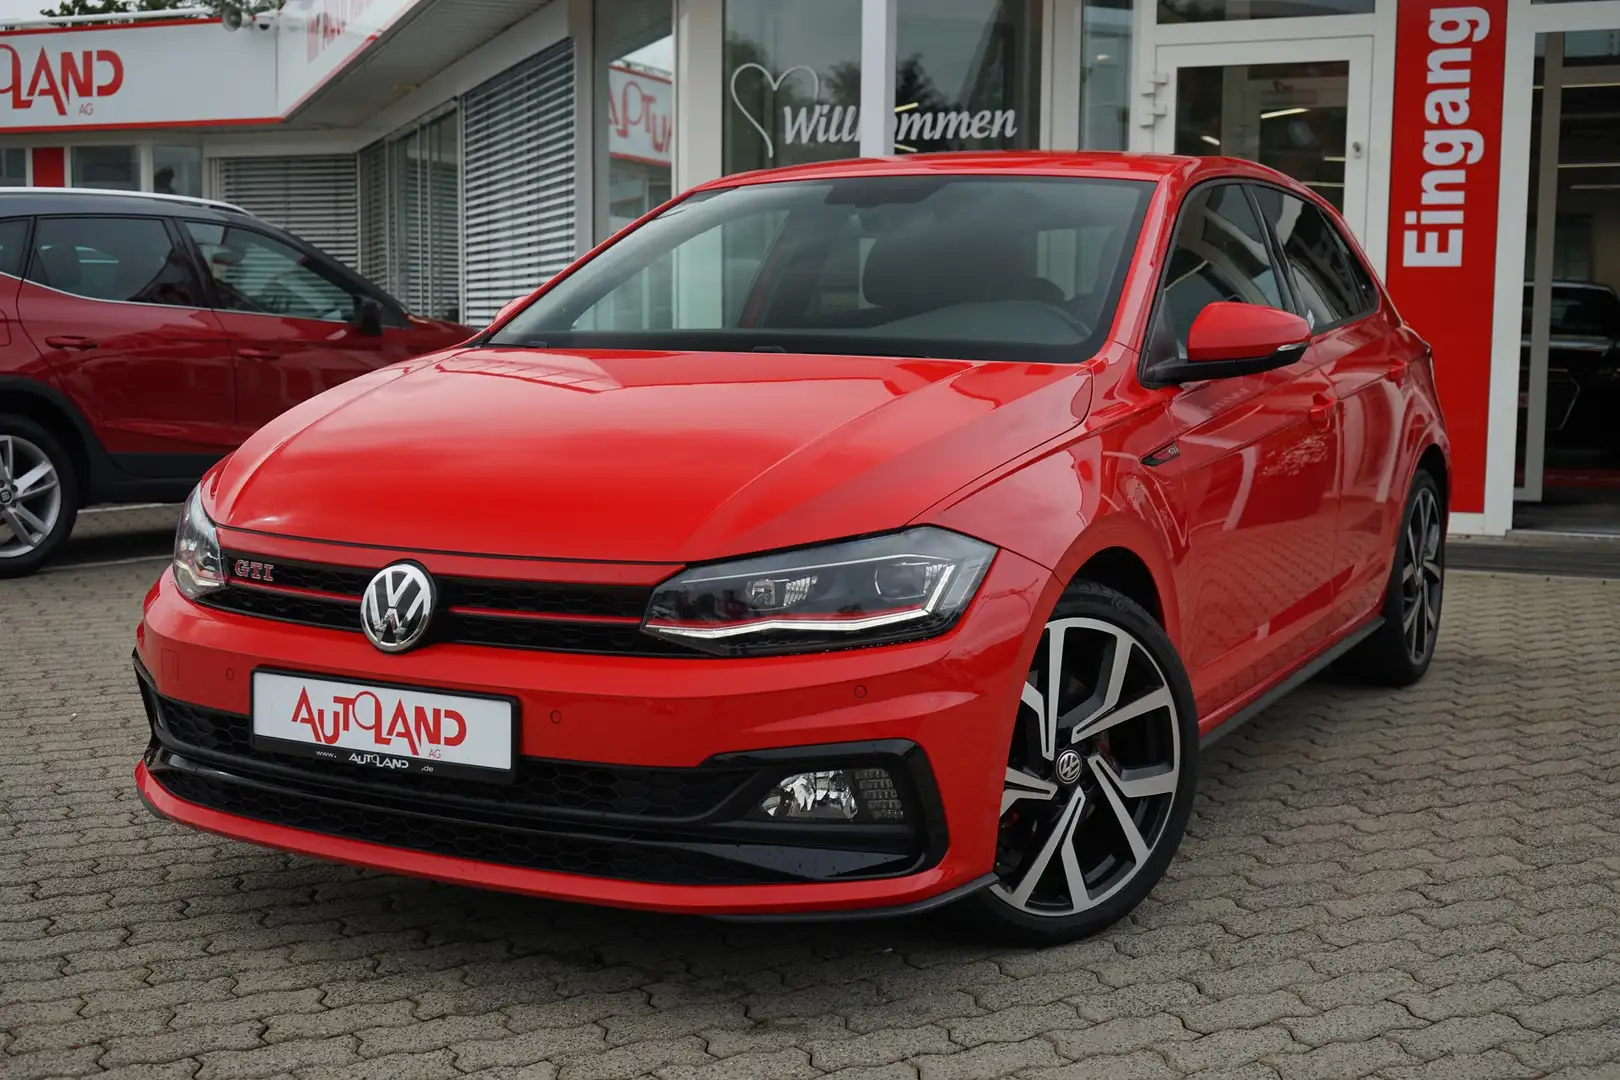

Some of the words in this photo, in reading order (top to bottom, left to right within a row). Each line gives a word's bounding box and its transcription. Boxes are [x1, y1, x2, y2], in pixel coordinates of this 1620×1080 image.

[79, 103, 94, 115] AG
[783, 104, 1018, 145] Willmmen
[1403, 6, 1491, 267] Eingang
[235, 559, 274, 581] GTI
[291, 686, 467, 756] AUTOLAND
[348, 752, 409, 769] AUTOLAND
[428, 748, 442, 759] AG
